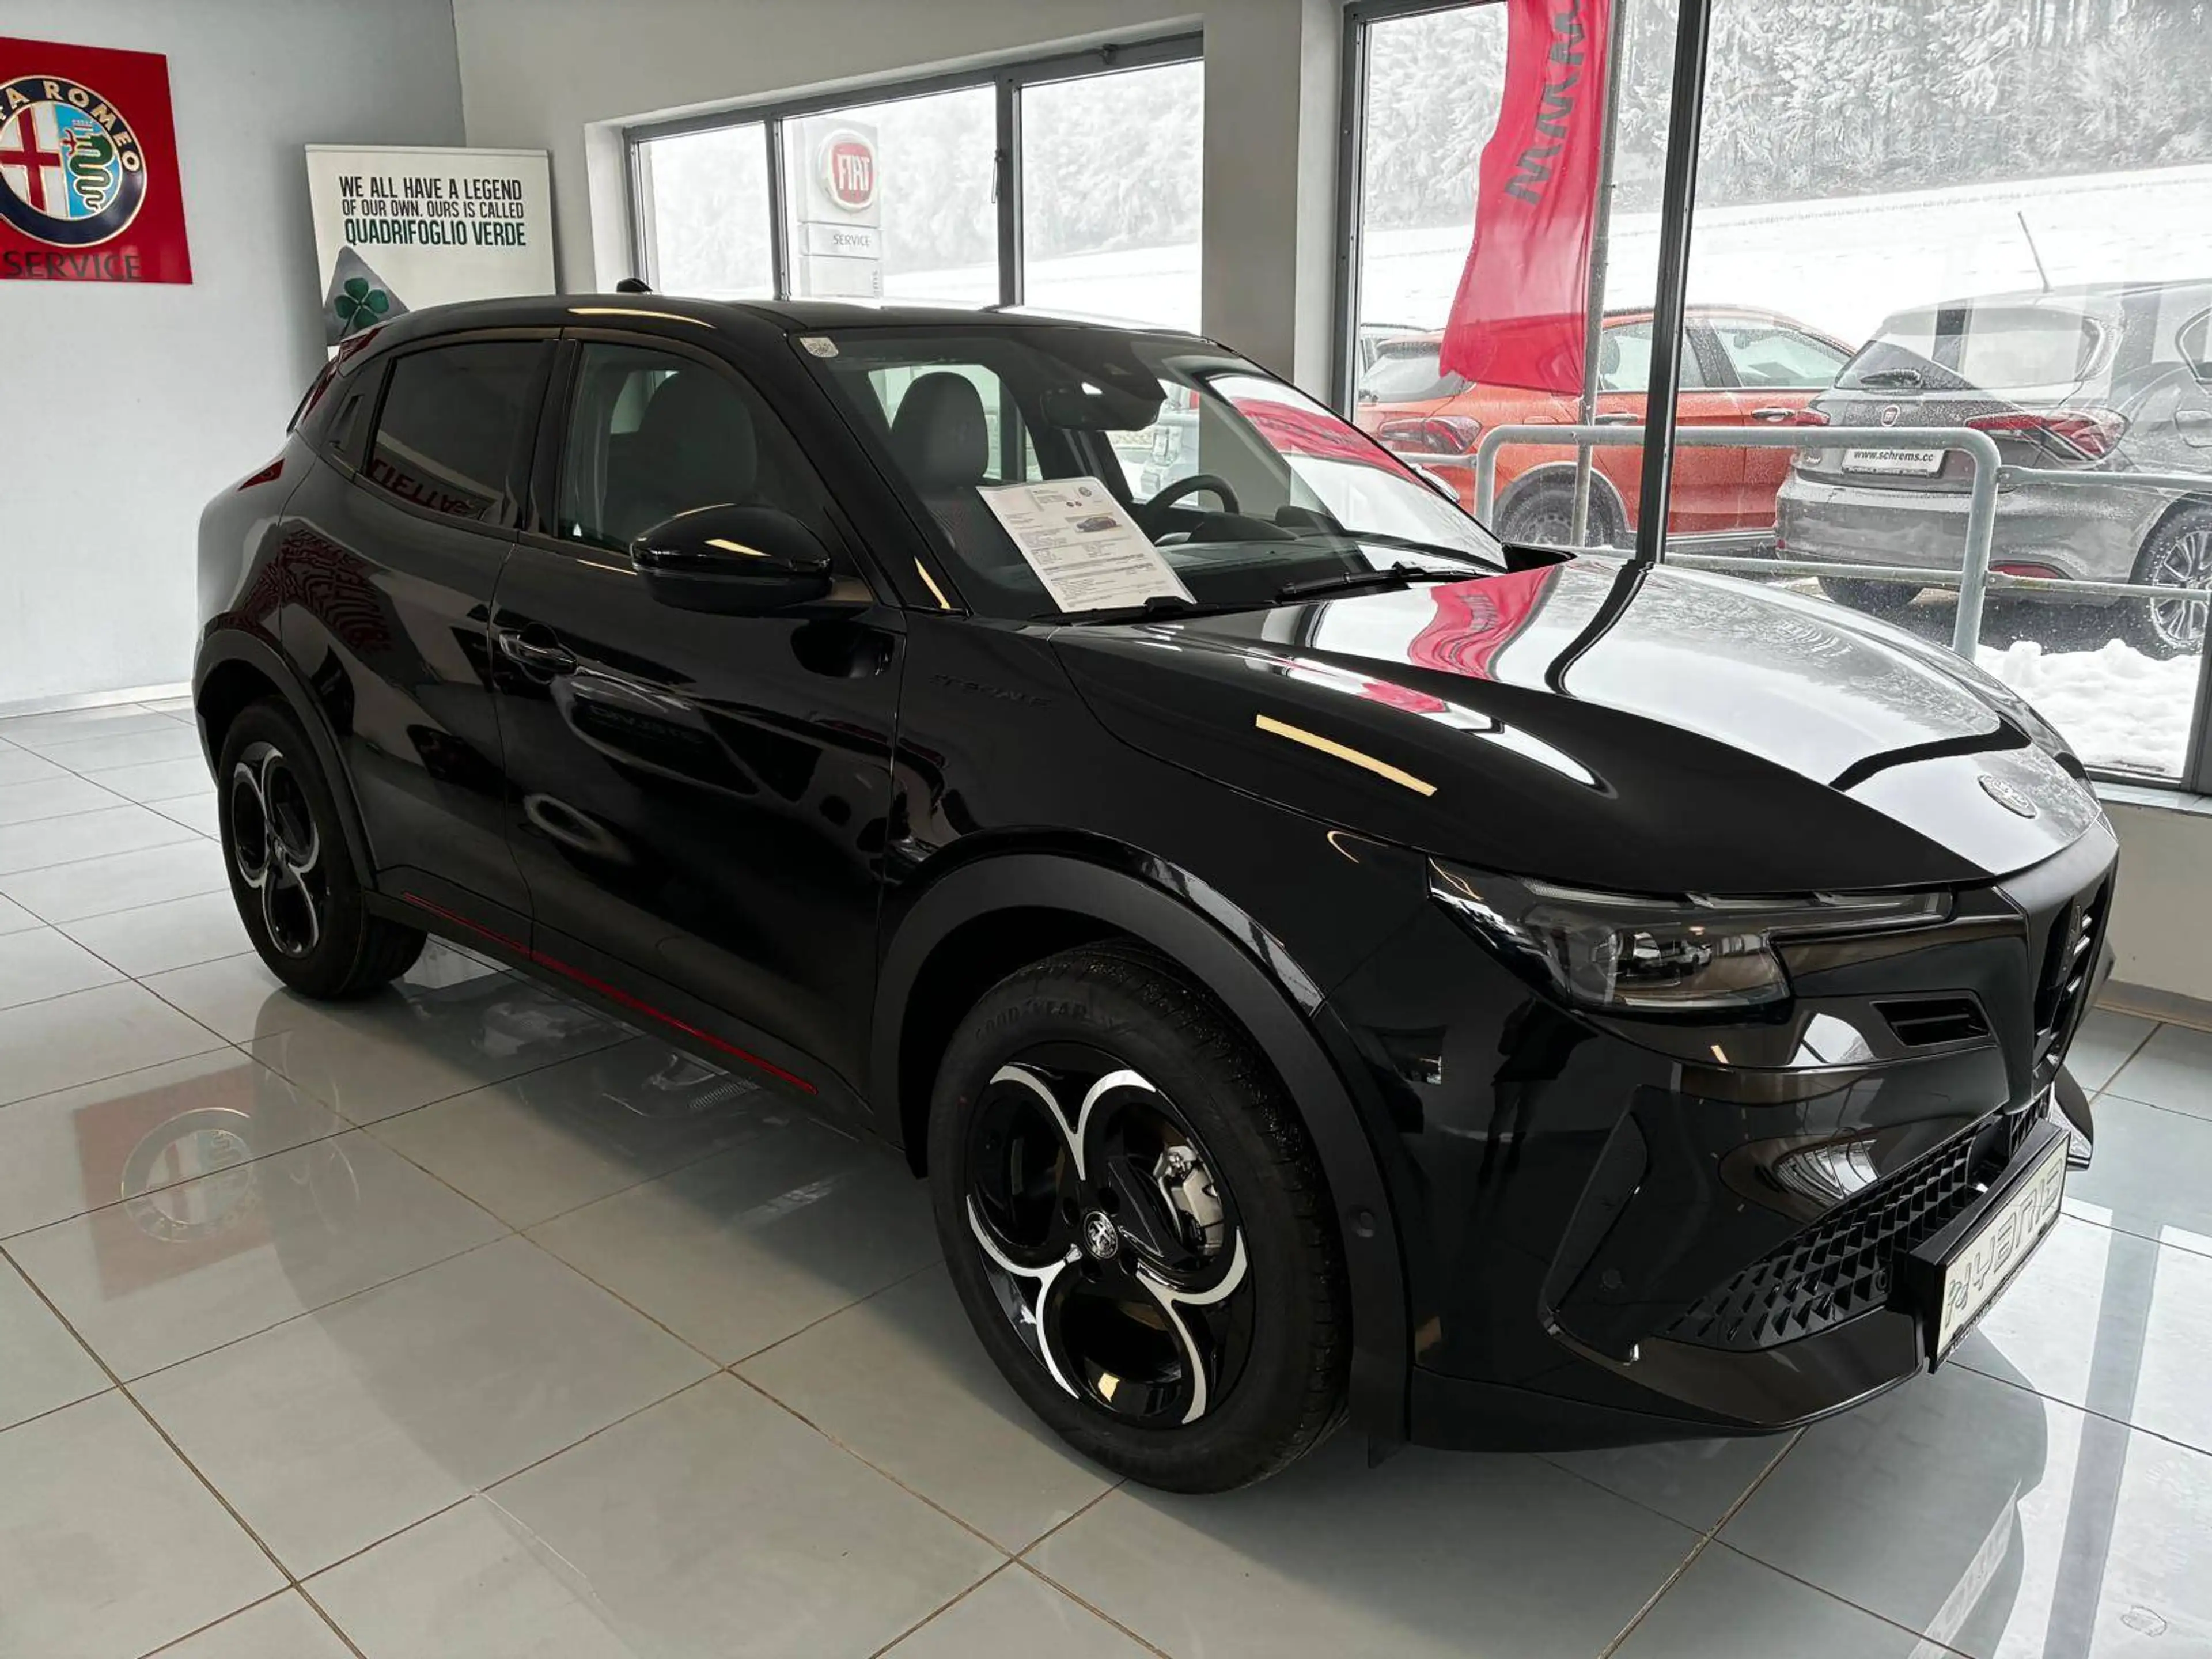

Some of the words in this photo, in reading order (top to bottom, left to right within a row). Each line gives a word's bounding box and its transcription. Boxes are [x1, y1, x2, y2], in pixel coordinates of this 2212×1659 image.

[43, 80, 141, 172] ROMEO
[837, 154, 870, 190] FIAT
[339, 176, 364, 198] WE
[370, 177, 397, 198] ALL
[404, 177, 443, 199] HAVE
[449, 178, 459, 199] A
[464, 179, 522, 200] LEGEND
[342, 199, 357, 216] OF
[362, 199, 387, 217] OUR
[391, 199, 423, 217] OWN.
[427, 200, 459, 218] OURS
[463, 201, 475, 218] IS
[479, 201, 524, 219] CALLED
[345, 218, 467, 246] QUADRIFOGLIO
[472, 221, 527, 246] VERDE
[833, 233, 872, 247] SERVICE
[3, 249, 141, 280] SERVICE
[1853, 449, 1934, 462] www.schrems.cc
